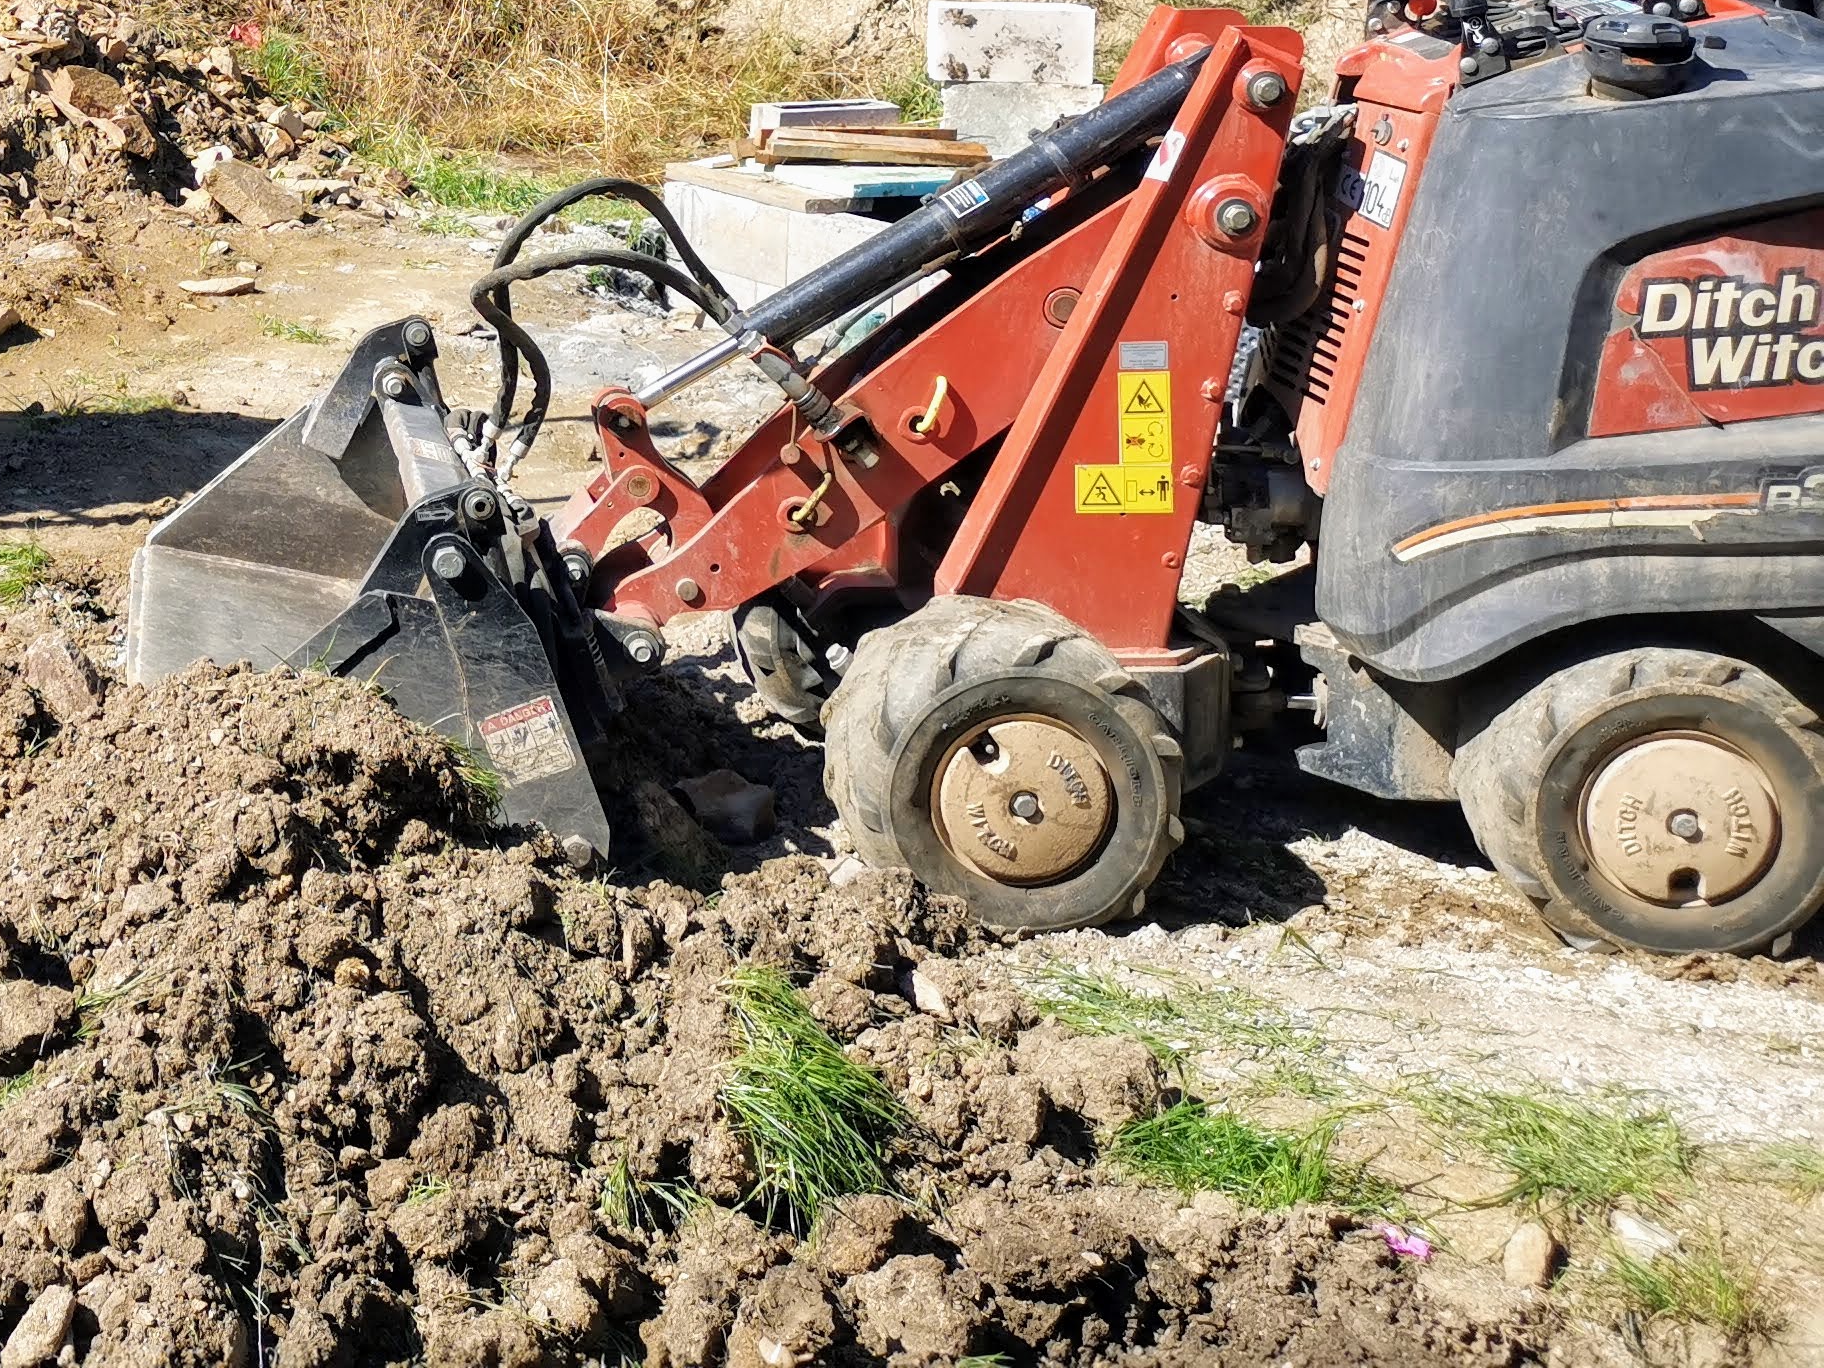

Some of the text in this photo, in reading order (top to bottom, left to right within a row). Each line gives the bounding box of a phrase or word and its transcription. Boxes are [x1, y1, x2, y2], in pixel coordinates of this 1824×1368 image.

[1640, 274, 1818, 334] Ditch
[1046, 750, 1091, 809] DITCH
[1616, 793, 1644, 859] DITCH
[1720, 786, 1756, 859] WITCH
